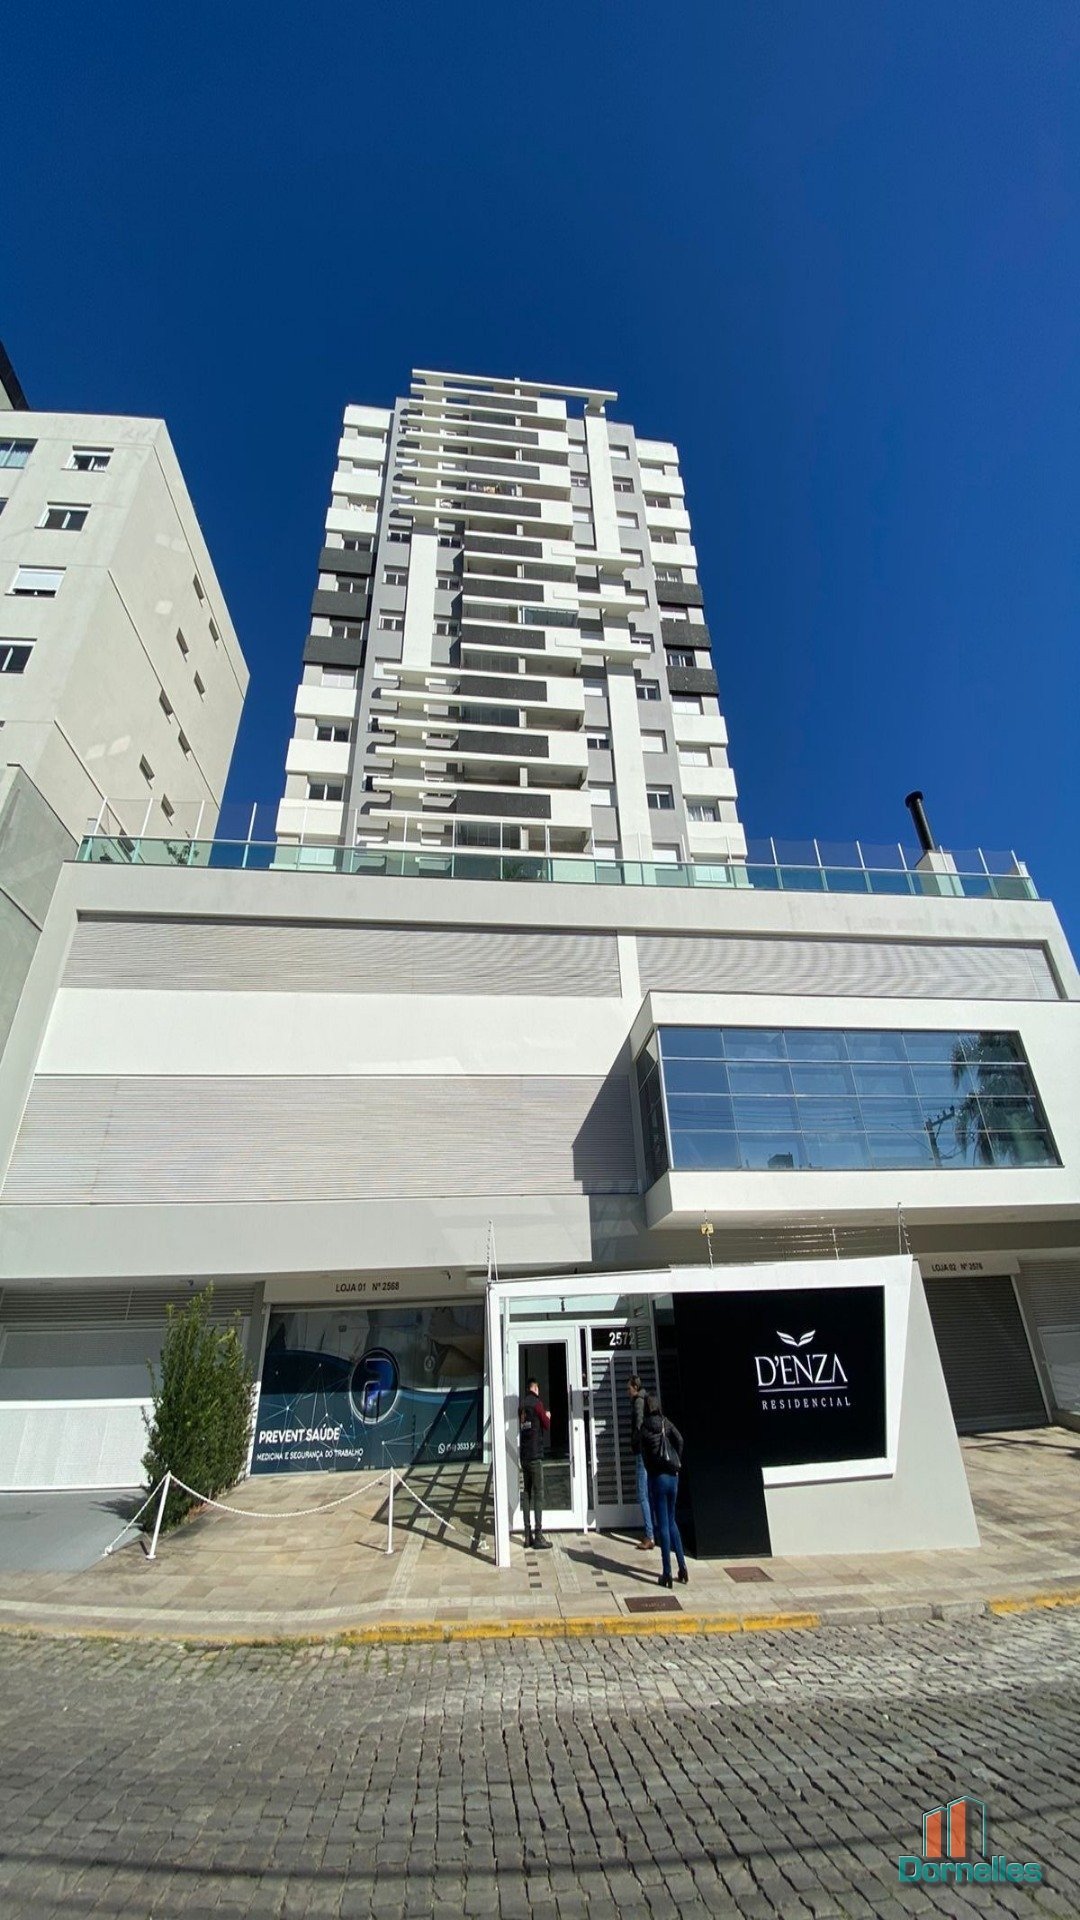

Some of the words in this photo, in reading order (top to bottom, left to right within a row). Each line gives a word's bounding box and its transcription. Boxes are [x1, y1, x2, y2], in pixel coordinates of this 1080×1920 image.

[931, 1264, 949, 1272] LOJA
[335, 1283, 356, 1292] LOJA
[357, 1282, 366, 1292] 01
[382, 1281, 400, 1291] 2568
[609, 1332, 635, 1346] 2572
[762, 1397, 851, 1410] RESIDENCIAL
[258, 1429, 306, 1444] PREVENT
[306, 1423, 341, 1442] SAÚDE
[256, 1452, 283, 1461] MEDICINA
[284, 1451, 289, 1460] E
[290, 1450, 323, 1461] SEGURANÇA
[324, 1449, 333, 1458] DO
[334, 1448, 364, 1457] TRABALHO
